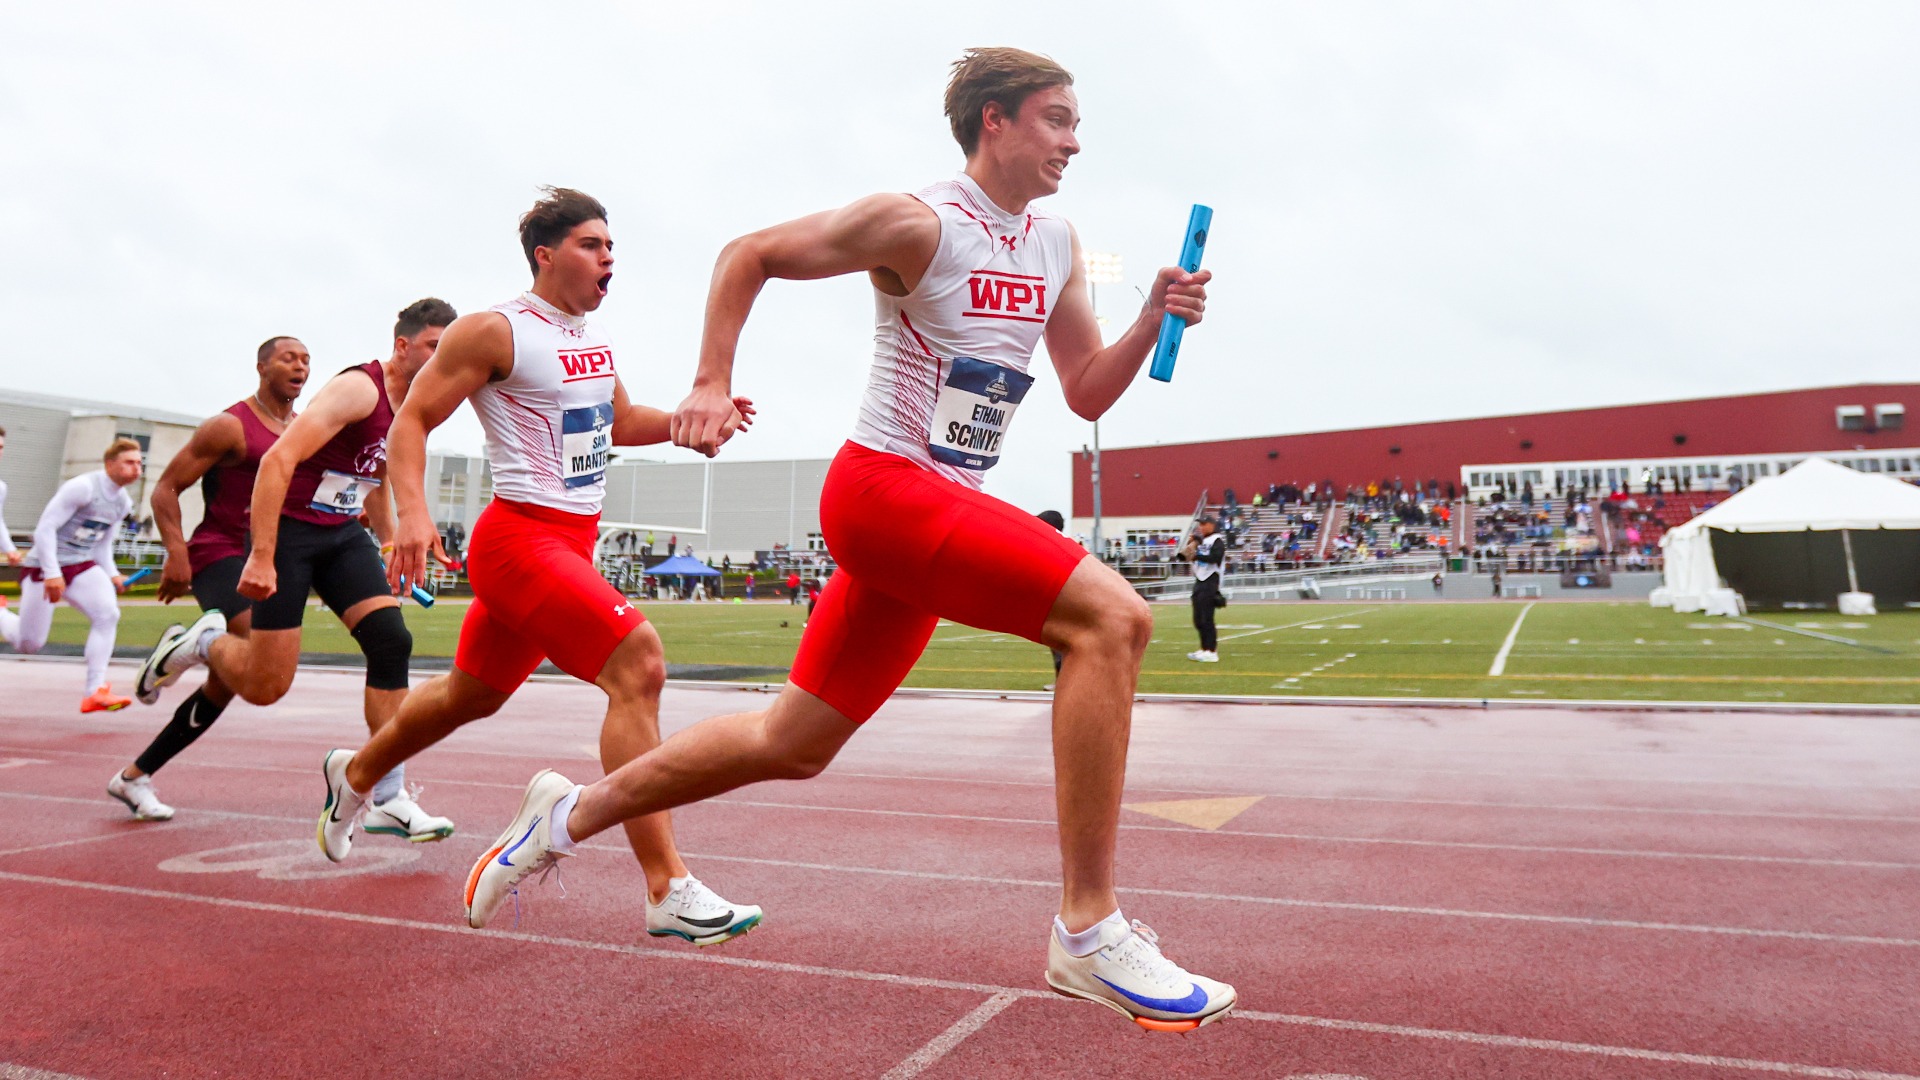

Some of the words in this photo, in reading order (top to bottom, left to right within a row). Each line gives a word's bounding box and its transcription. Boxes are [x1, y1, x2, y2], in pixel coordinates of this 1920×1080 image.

[968, 278, 1046, 315] WPI
[559, 351, 614, 376] WPI
[972, 404, 1005, 427] ETHAN
[593, 434, 607, 449] SAM
